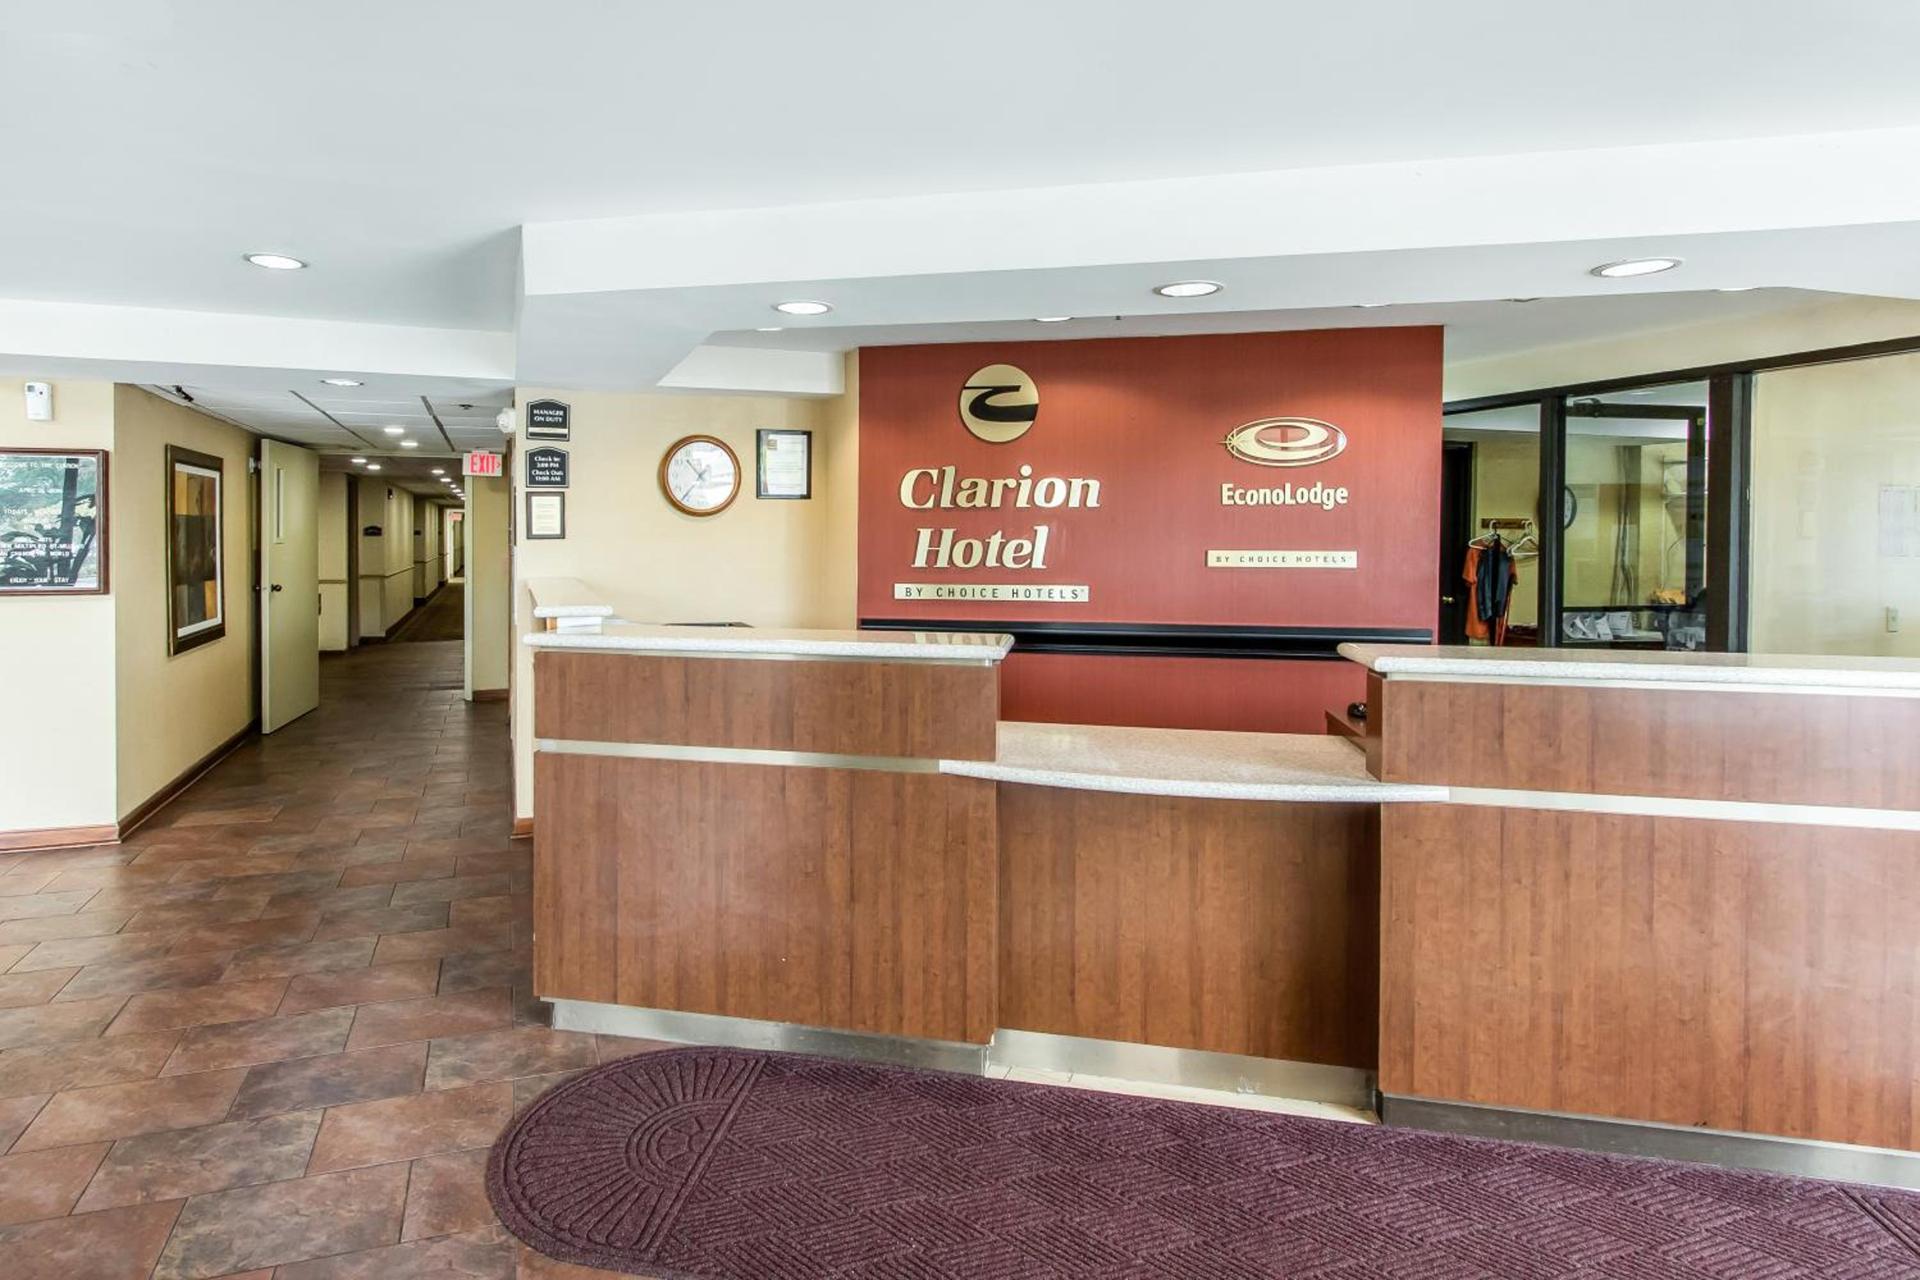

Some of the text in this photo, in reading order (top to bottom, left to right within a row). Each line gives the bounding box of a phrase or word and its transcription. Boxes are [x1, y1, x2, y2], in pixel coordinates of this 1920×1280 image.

[470, 454, 496, 473] EXIT
[900, 464, 1100, 508] Clarion
[1221, 482, 1349, 510] EconoLodge
[910, 525, 1049, 569] Hotel
[1240, 556, 1287, 564] CHOICE
[1296, 556, 1347, 564] HOTELS
[905, 586, 1084, 599] BY CHOICE HOTELS
